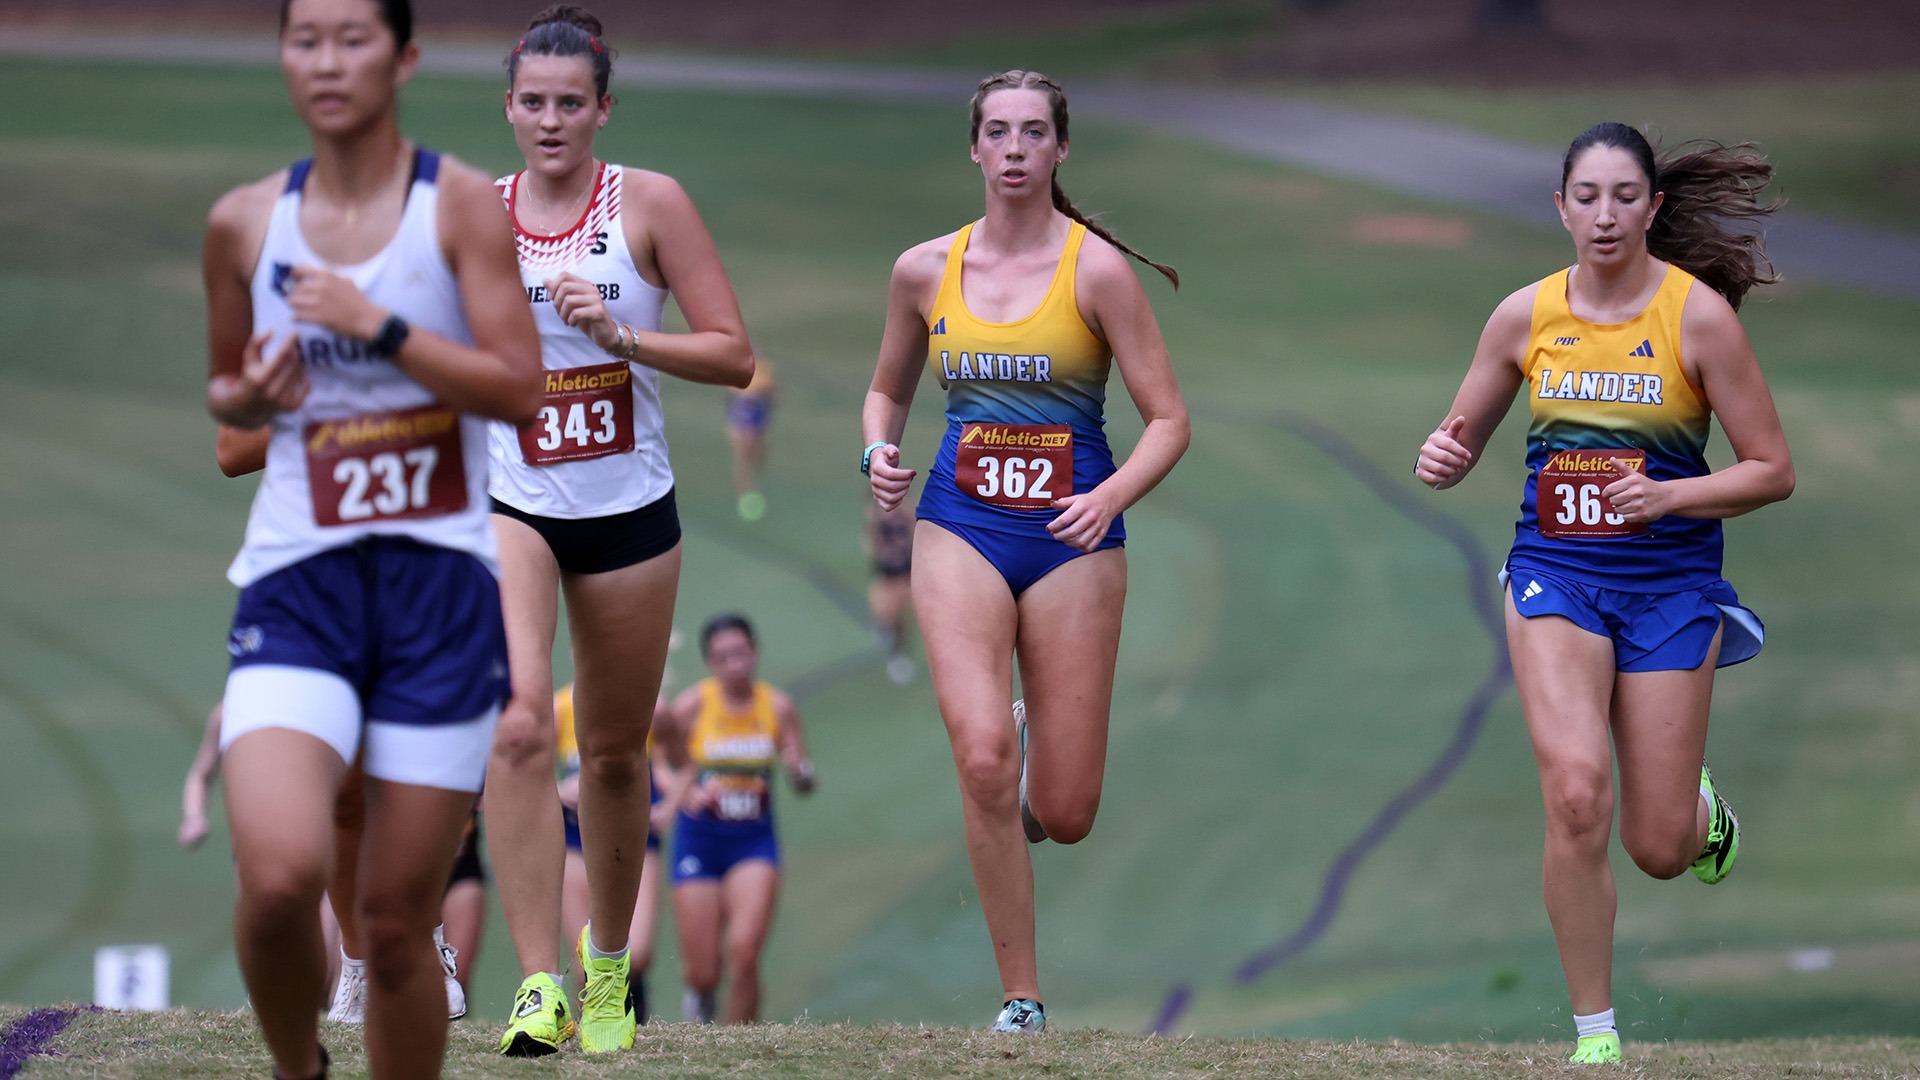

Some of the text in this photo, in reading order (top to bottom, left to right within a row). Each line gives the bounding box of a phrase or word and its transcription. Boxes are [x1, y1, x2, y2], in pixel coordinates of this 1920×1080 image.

[1553, 336, 1581, 346] PBC
[545, 372, 600, 392] hletic
[941, 351, 1052, 383] LANDER
[1538, 369, 1663, 405] LANDER
[536, 400, 616, 451] 343
[961, 426, 1067, 446] Athletic NET
[332, 446, 439, 521] 237
[976, 456, 1053, 499] 362
